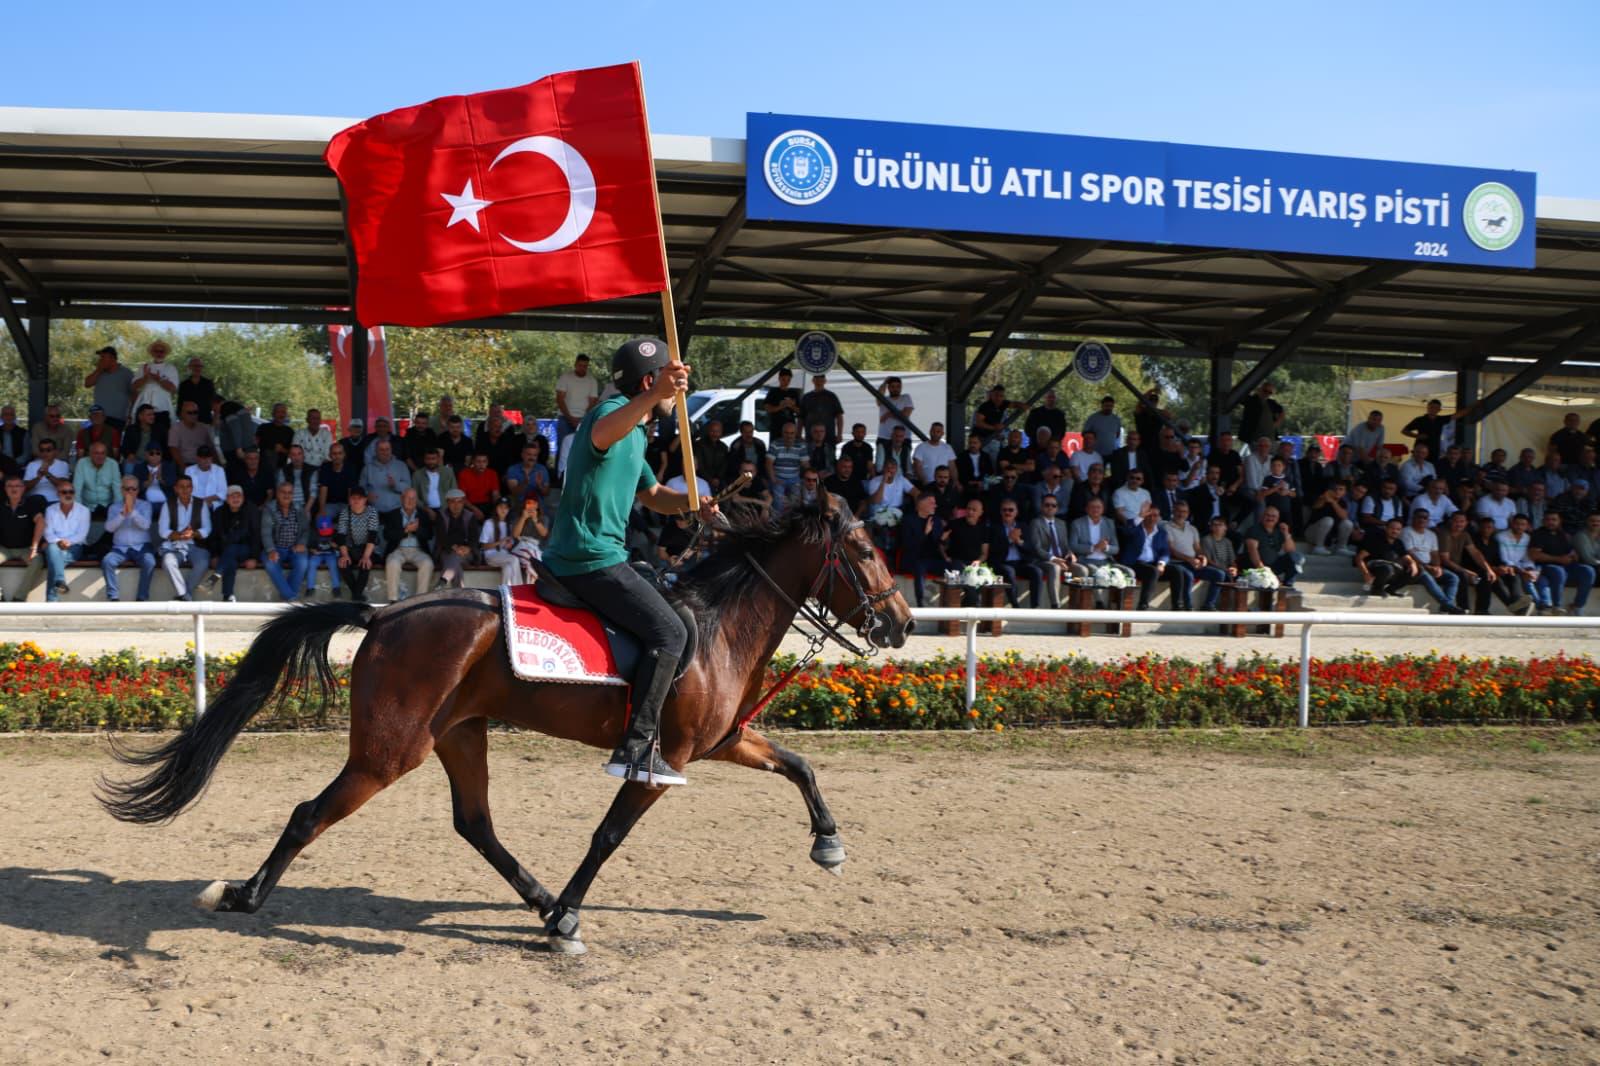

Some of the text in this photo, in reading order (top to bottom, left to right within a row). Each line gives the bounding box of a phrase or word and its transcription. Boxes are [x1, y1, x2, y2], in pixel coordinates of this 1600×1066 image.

[787, 136, 816, 148] BURSA
[853, 148, 992, 194] ÜRÜNLÜ
[1000, 167, 1072, 200] ATLI
[1079, 172, 1165, 207] SPOR
[1172, 175, 1272, 214] TESİSİ
[1278, 187, 1367, 228] YARIŞ
[1375, 188, 1450, 227] PİSTİ
[1414, 241, 1449, 257] 2024
[517, 630, 578, 675] KLEOPATRA
